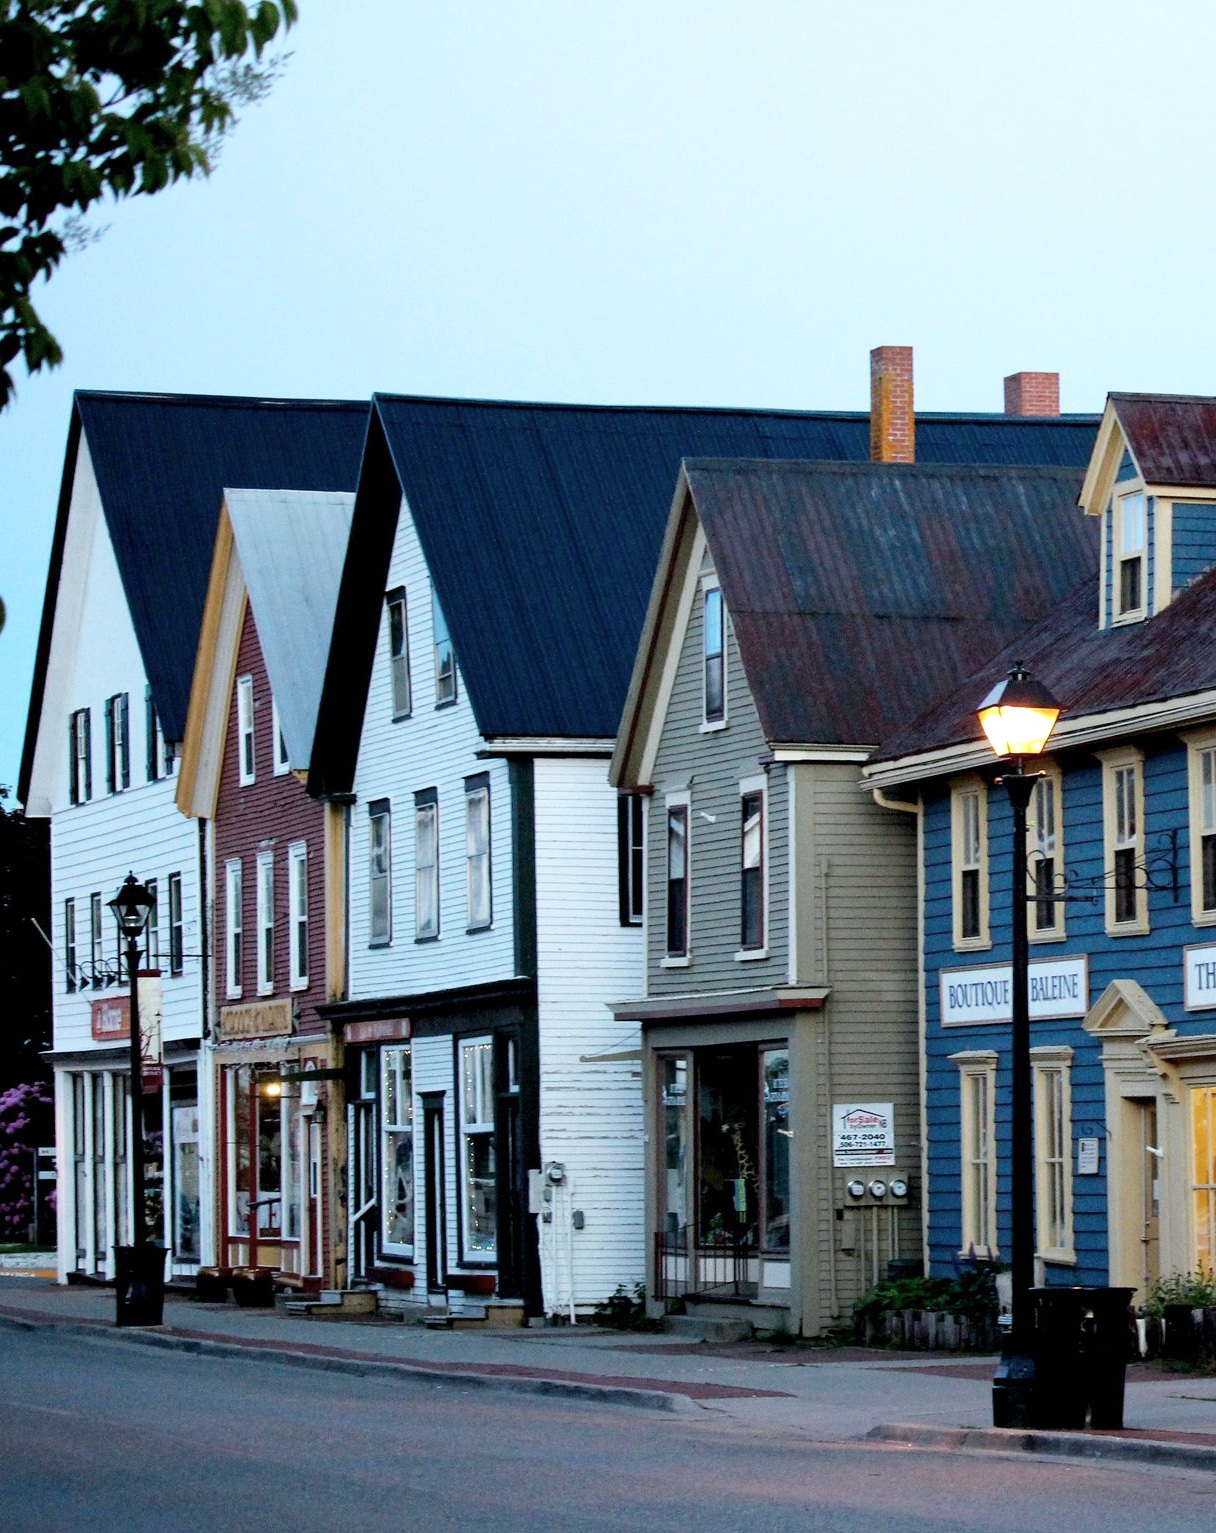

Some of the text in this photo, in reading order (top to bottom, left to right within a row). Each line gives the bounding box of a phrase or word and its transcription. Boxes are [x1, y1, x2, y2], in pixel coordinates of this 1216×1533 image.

[948, 973, 1079, 1012] BOUTIQUE BALEINE
[840, 1133, 886, 1141] 467-2040
